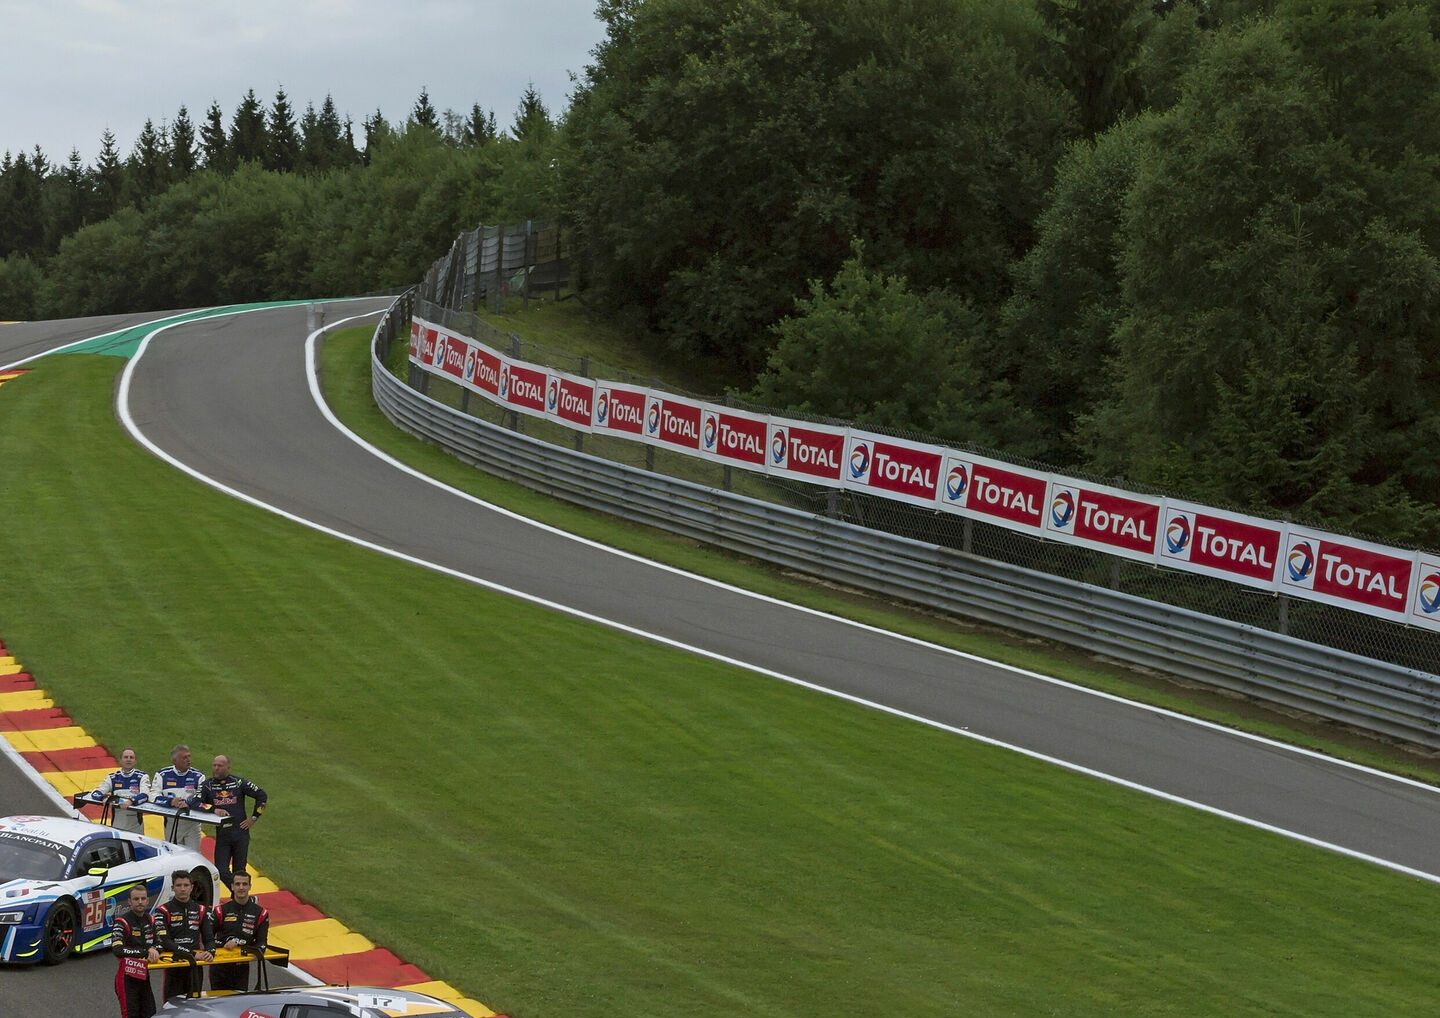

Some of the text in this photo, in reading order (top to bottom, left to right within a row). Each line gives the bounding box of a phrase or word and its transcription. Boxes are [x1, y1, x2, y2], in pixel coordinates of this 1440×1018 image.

[446, 344, 464, 370] TOTAL
[477, 358, 498, 387] TOTAL
[511, 374, 543, 403] TOTAL
[560, 388, 590, 417] TOTAL
[611, 398, 643, 425] TOTAL
[663, 410, 698, 440] TOTAL
[720, 424, 764, 455] TOTAL
[790, 437, 839, 469] TOTAL
[875, 452, 935, 489] TOTAL
[974, 475, 1040, 516] TOTAL
[1081, 501, 1152, 542] TOTAL
[1198, 526, 1273, 569] TOTAL
[1322, 554, 1403, 600] TOTAL
[0, 832, 62, 851] BLANCPAIN
[85, 903, 102, 926] 26
[125, 958, 146, 969] TOTAL
